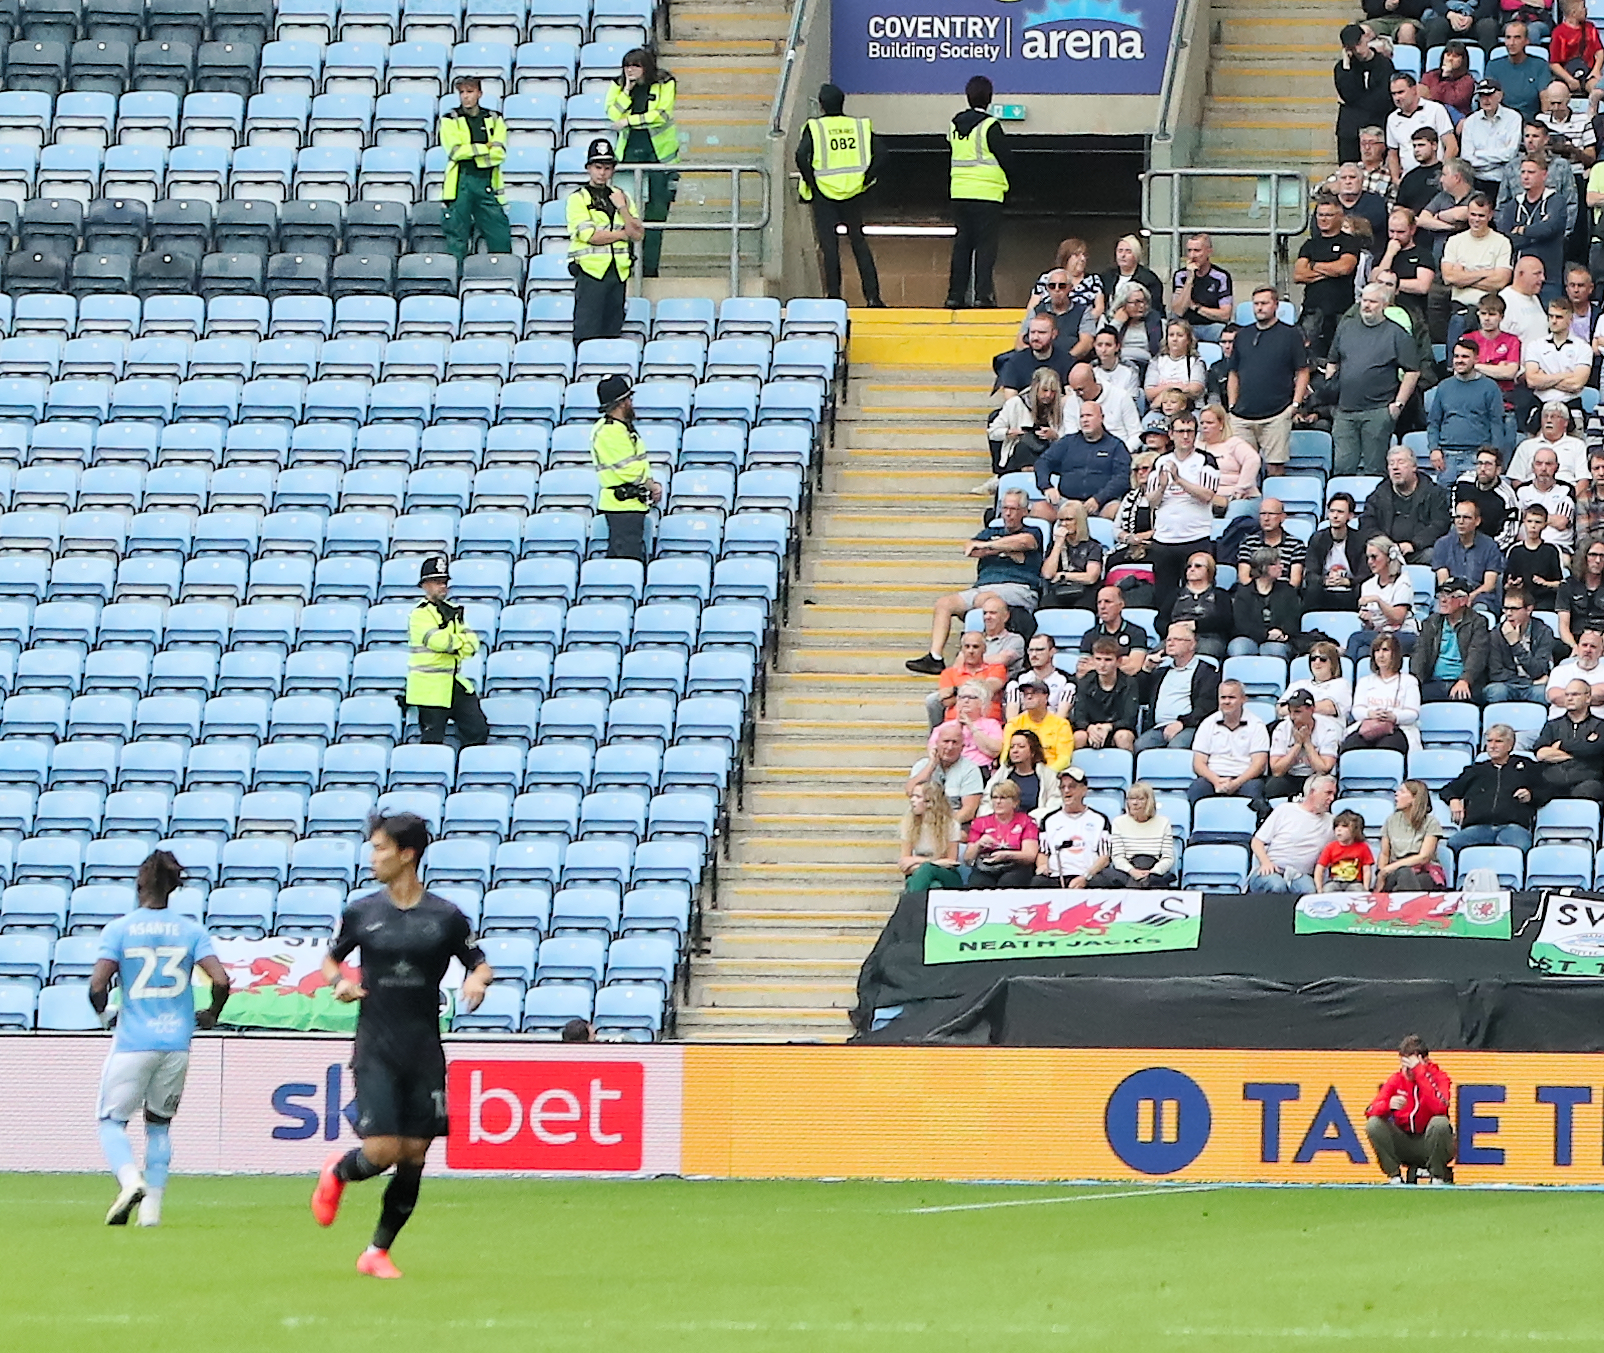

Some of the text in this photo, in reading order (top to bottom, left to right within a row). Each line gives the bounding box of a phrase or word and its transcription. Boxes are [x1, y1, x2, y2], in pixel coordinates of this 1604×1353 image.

[868, 16, 1146, 61] COVENTRY arena
[868, 42, 1001, 63] Building Society
[830, 137, 856, 151] 082
[129, 922, 180, 937] ASANTE
[958, 937, 1163, 952] NEATH JACKS
[124, 946, 190, 1000] 23
[271, 1063, 358, 1142] sk
[468, 1070, 623, 1146] bet
[1243, 1082, 1505, 1166] TAE
